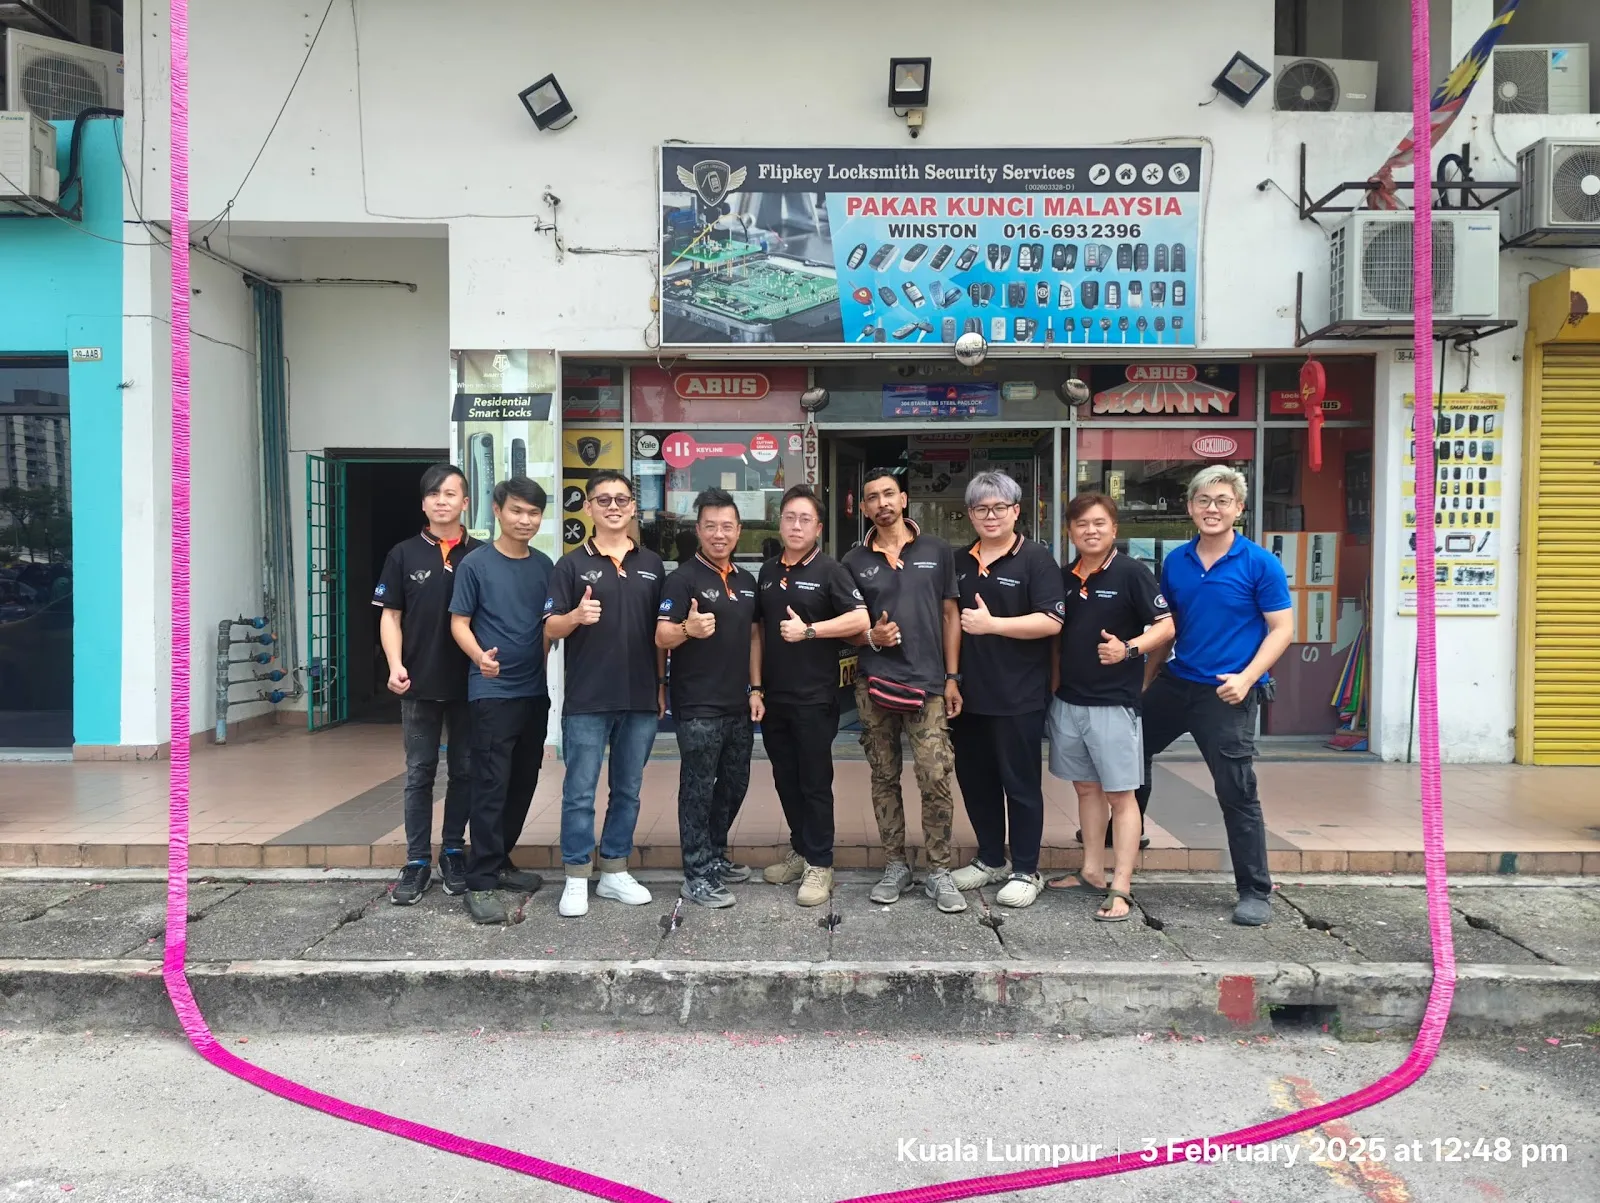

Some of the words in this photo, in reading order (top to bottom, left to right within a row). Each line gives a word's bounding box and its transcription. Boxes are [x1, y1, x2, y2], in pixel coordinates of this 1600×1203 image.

[758, 164, 823, 183] Flipkey
[828, 163, 919, 180] Locksmith
[925, 164, 998, 183] Security
[1002, 164, 1075, 180] Services
[847, 197, 938, 216] PAKAR
[948, 197, 1034, 216] KUNCI
[1044, 196, 1182, 216] MALAYSIA
[888, 224, 977, 239] WINSTON
[1133, 366, 1188, 379] ABUS
[685, 378, 757, 394] ABUS
[473, 396, 531, 407] Residential
[1092, 391, 1236, 414] SECURITY
[468, 408, 500, 418] Smart
[502, 407, 532, 418] Locks
[640, 441, 656, 449] Yale
[1197, 440, 1233, 453] LOCKWOOD
[805, 424, 817, 484] ABUS
